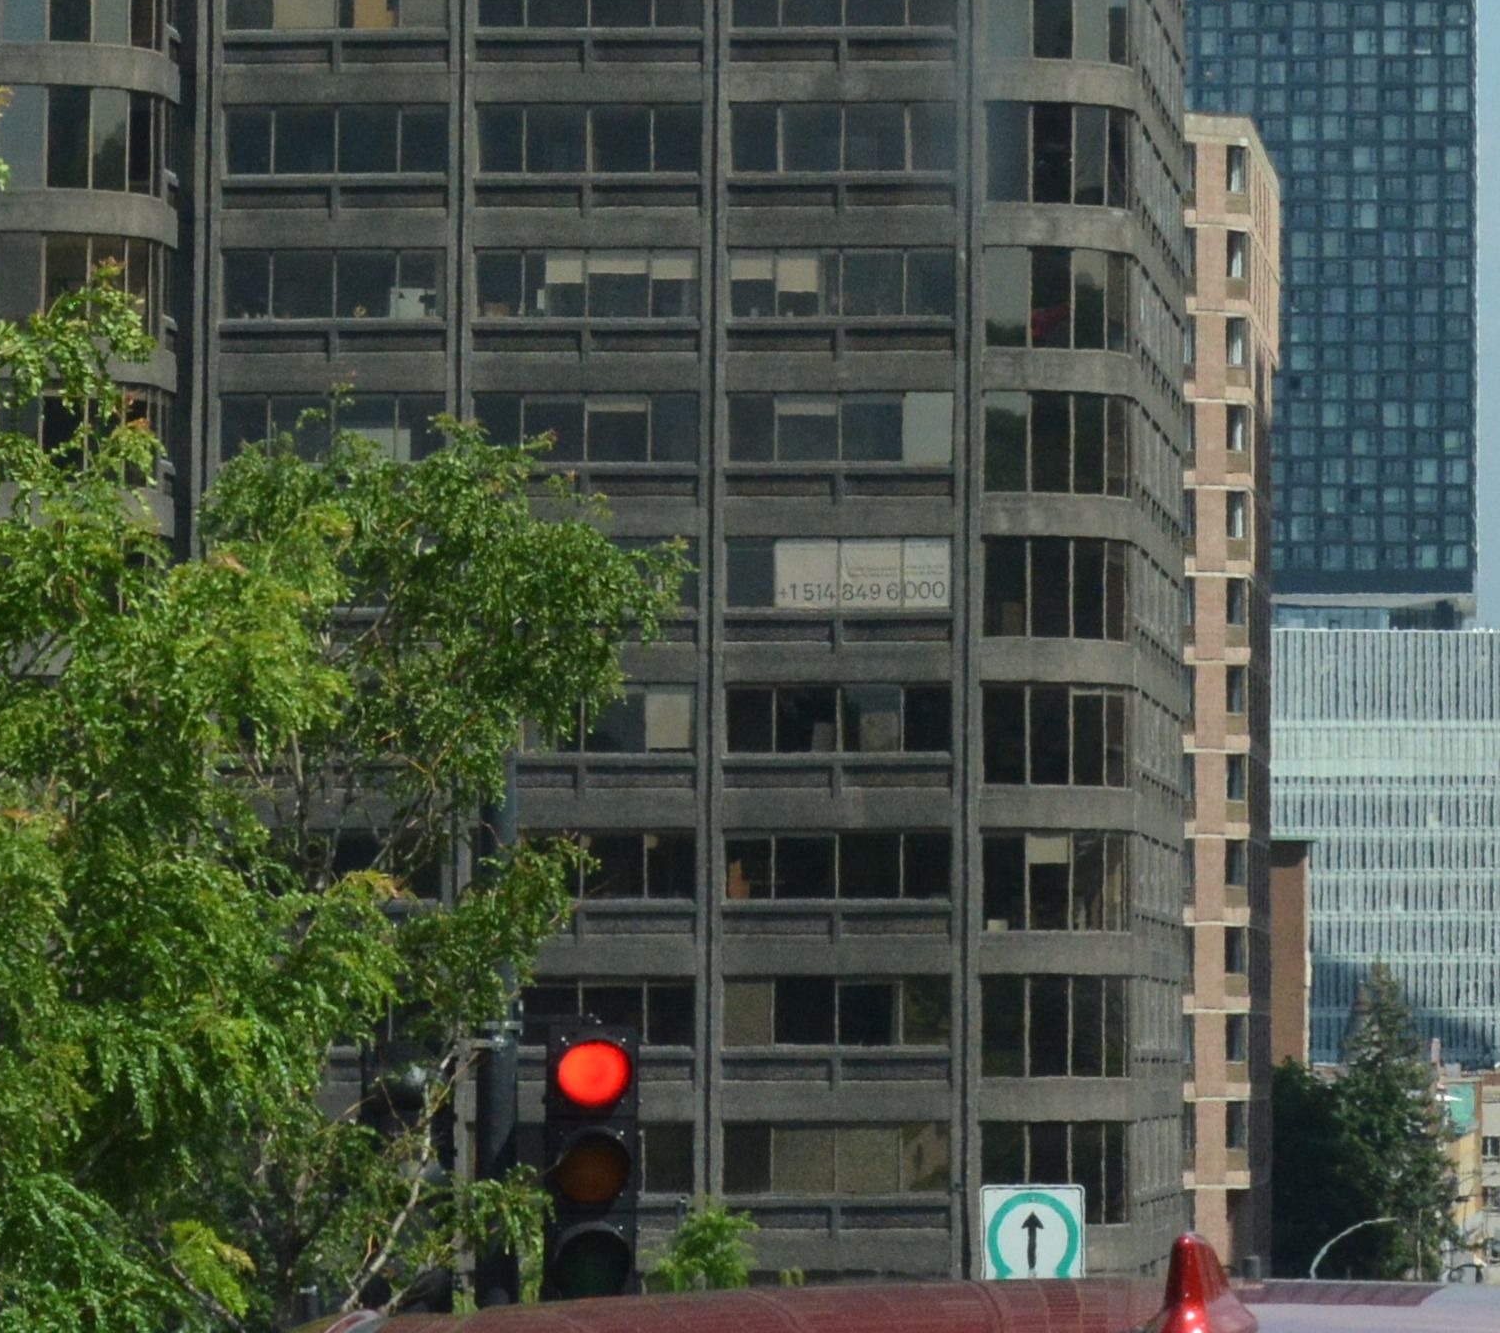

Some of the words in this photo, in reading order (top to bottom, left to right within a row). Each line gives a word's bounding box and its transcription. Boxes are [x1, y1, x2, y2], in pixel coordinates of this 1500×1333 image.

[779, 583, 797, 600] +1
[803, 582, 836, 601] 514
[842, 583, 881, 601] 849
[886, 581, 946, 601] 6000
